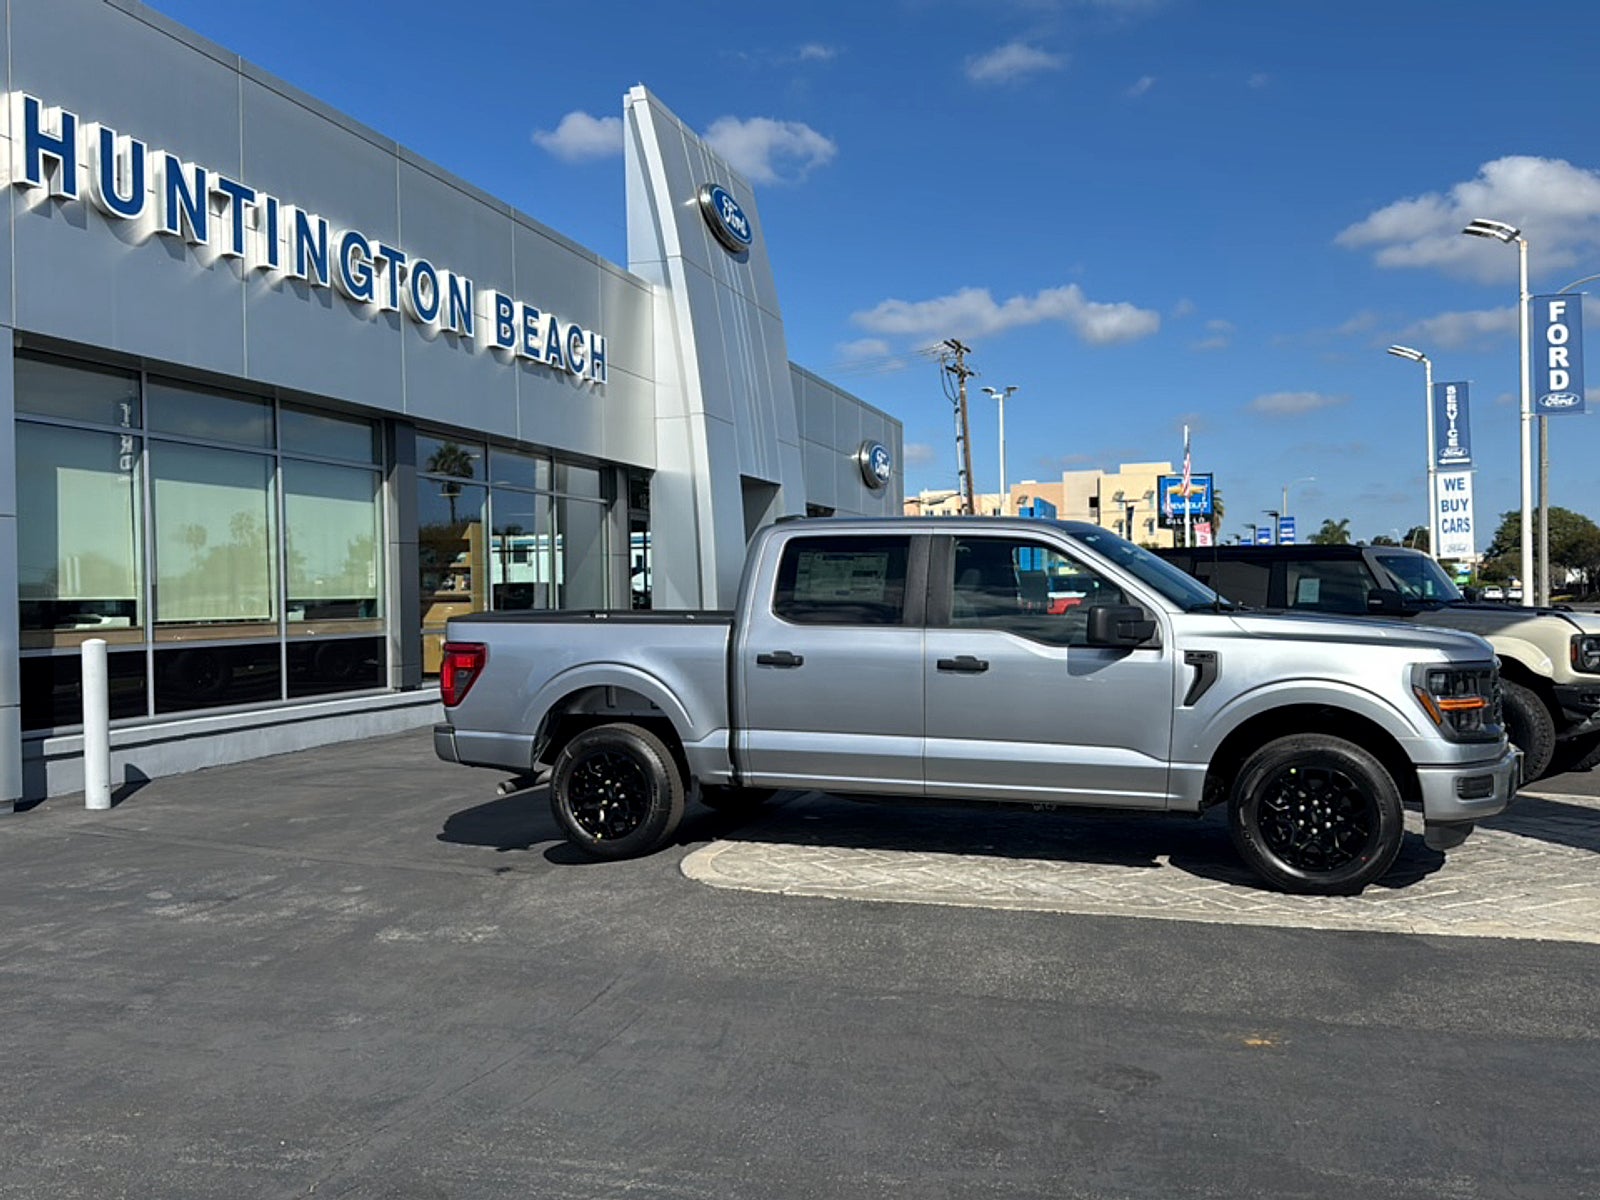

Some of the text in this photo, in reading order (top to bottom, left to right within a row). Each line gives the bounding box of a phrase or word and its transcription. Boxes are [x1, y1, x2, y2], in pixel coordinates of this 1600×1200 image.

[721, 195, 747, 237] Ford
[18, 92, 608, 384] HUNTINGTON BEACH
[1547, 301, 1569, 391] FORD
[1446, 385, 1458, 446] SERVICE
[874, 450, 890, 477] Ford
[1444, 478, 1465, 491] WE
[1441, 498, 1469, 512] BUY
[1442, 518, 1471, 533] CARS
